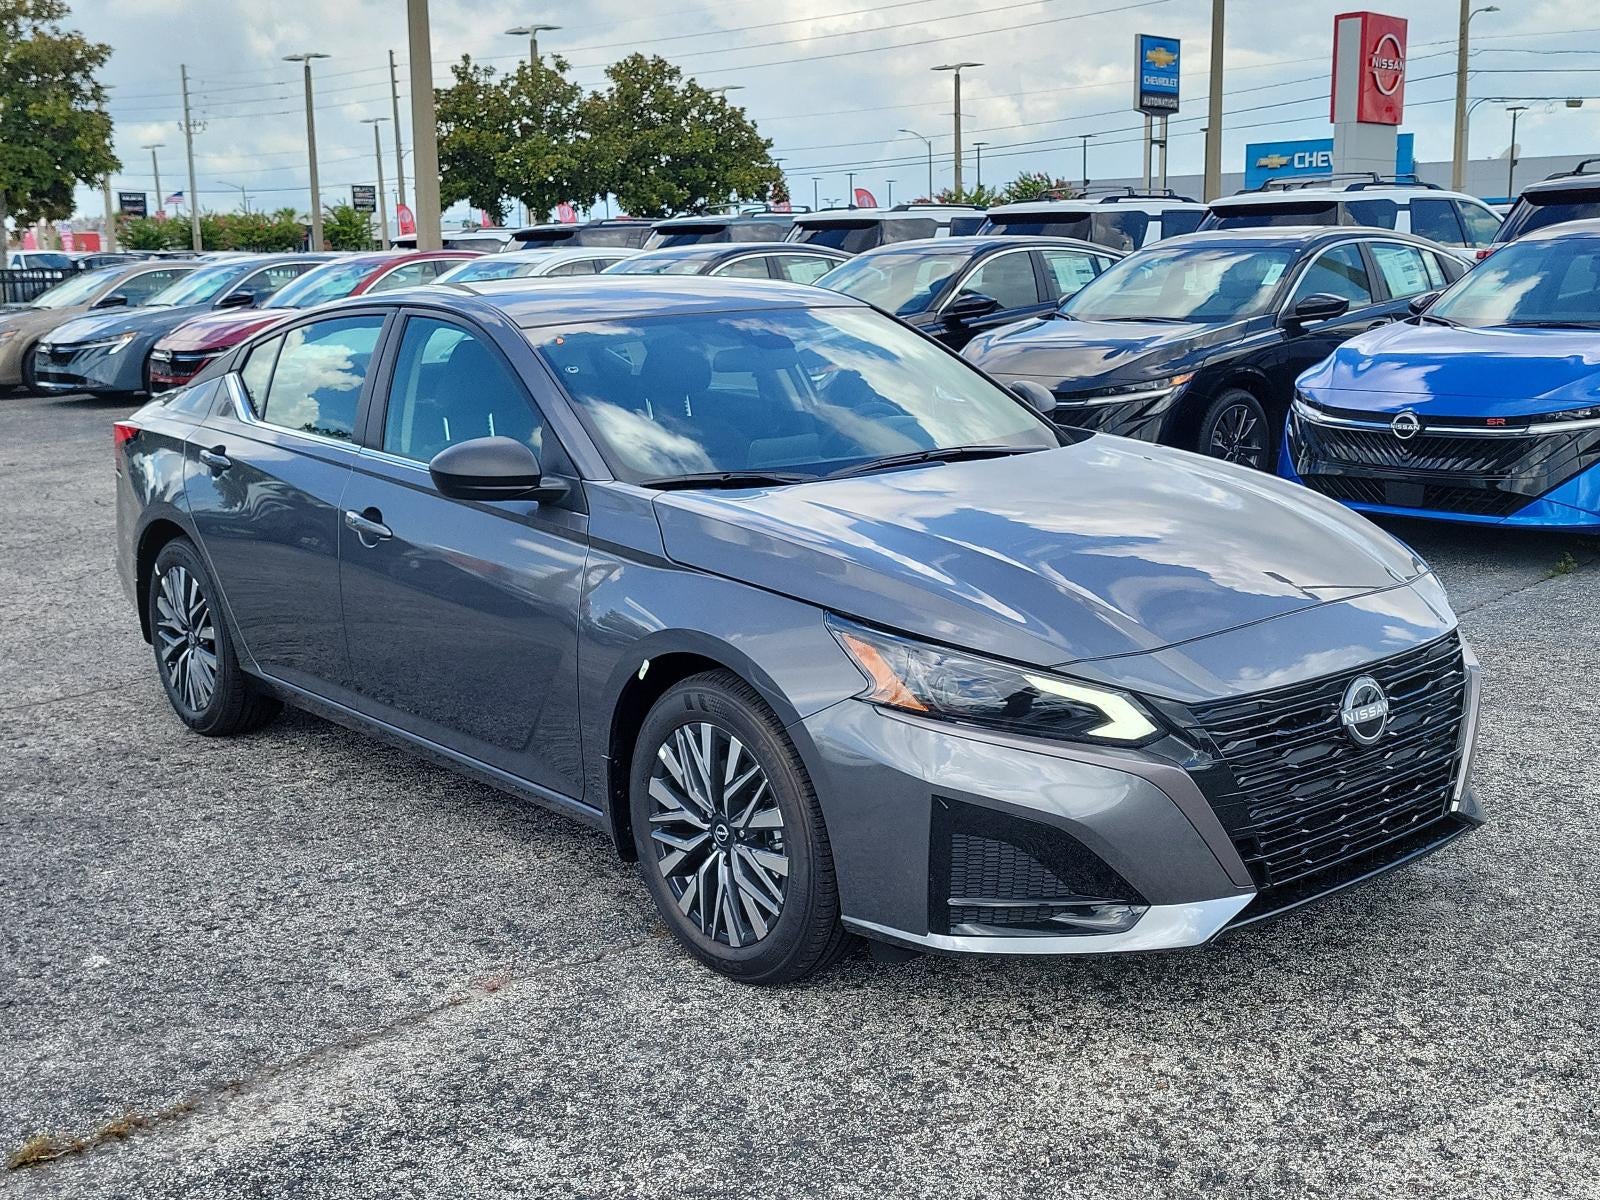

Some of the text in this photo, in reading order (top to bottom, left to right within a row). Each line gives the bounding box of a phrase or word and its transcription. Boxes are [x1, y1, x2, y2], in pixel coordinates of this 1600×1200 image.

[1371, 57, 1404, 71] NISSAN
[1144, 75, 1177, 87] CHEVROLET
[1391, 423, 1420, 431] NISSAN
[1343, 701, 1388, 724] NISSAN
